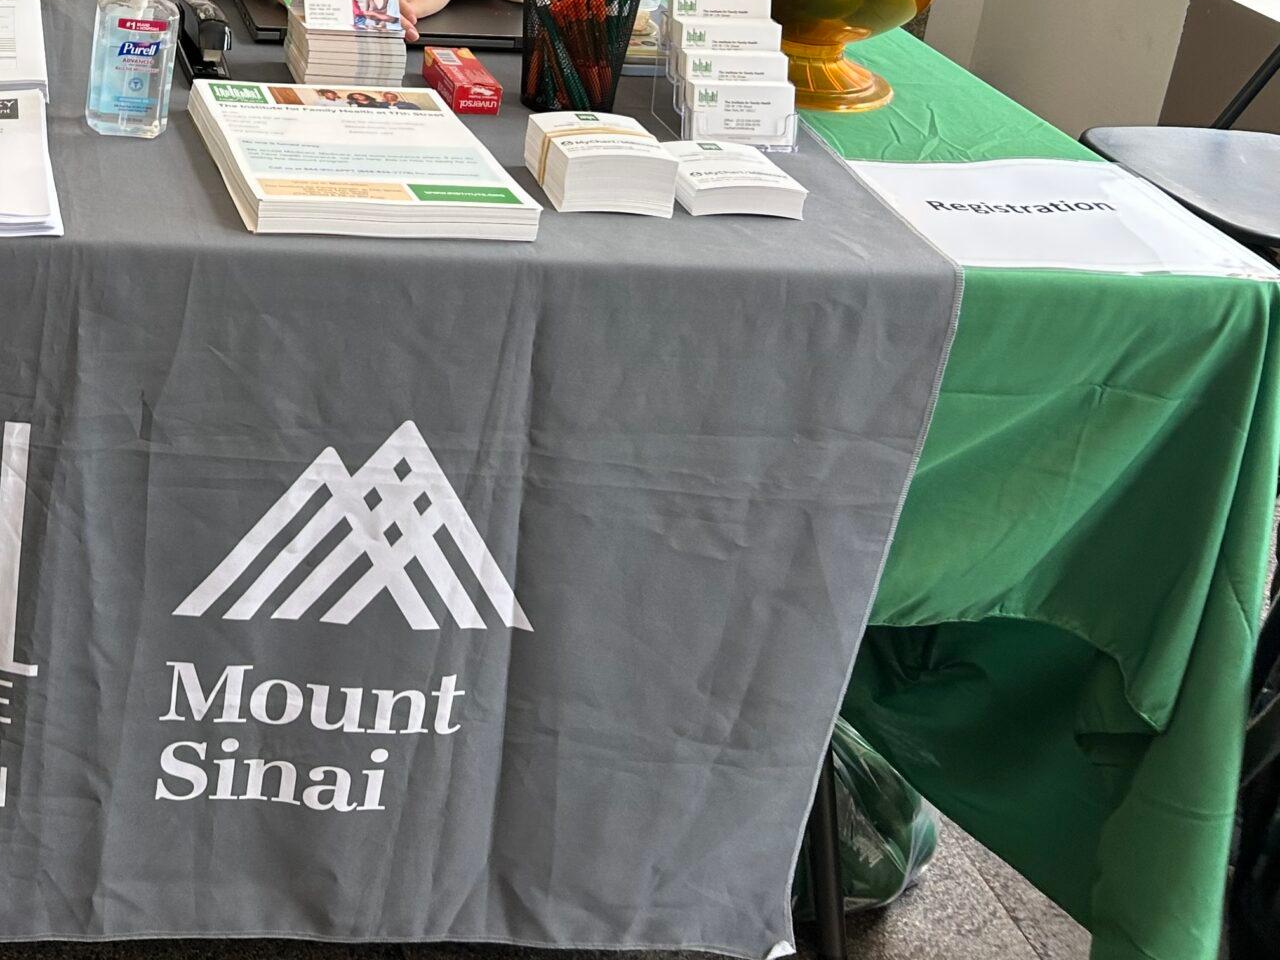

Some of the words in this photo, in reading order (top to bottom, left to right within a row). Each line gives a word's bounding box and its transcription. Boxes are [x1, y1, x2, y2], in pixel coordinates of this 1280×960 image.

[124, 42, 157, 56] Purell
[460, 100, 497, 110] universal
[925, 200, 1117, 214] Registration
[159, 661, 465, 735] Mount
[155, 737, 389, 812] Sinai
